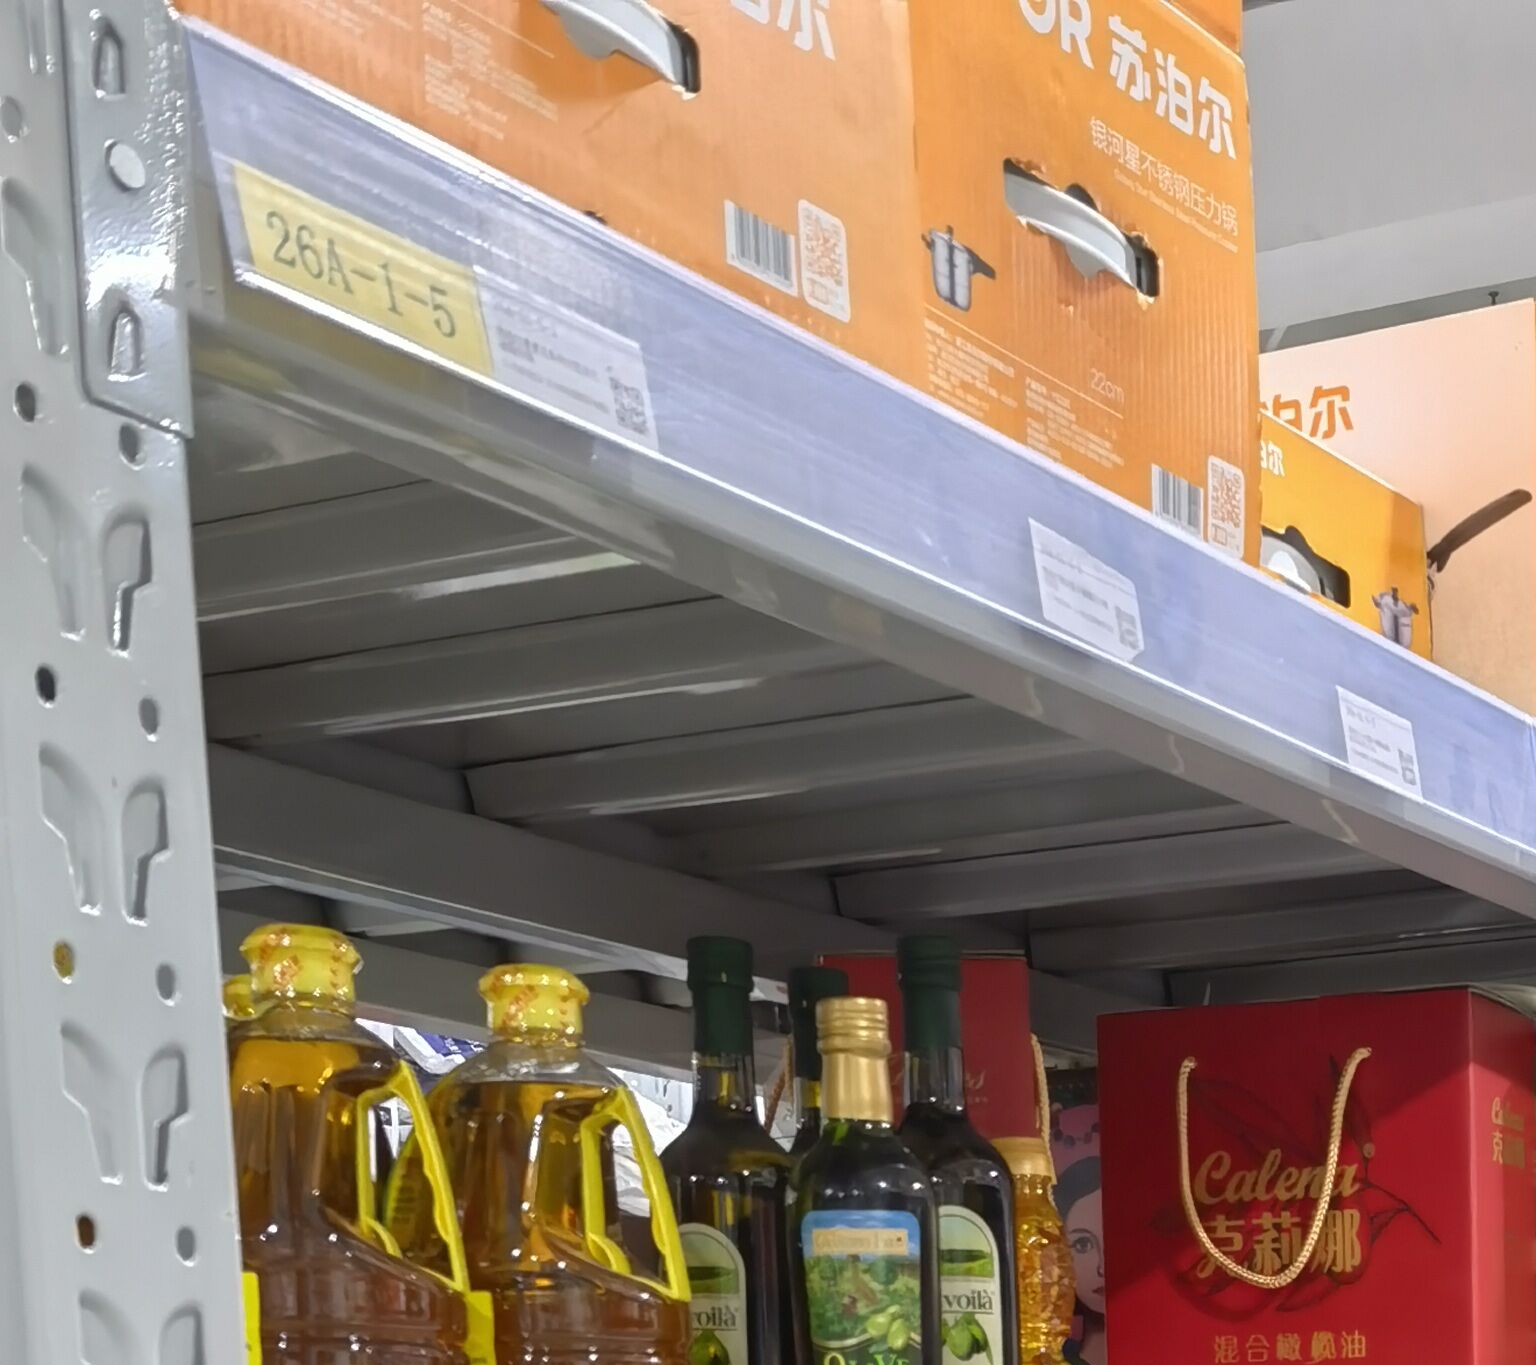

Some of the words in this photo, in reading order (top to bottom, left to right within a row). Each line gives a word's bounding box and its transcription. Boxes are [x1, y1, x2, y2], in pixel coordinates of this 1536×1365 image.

[1108, 15, 1237, 160] 苏泊尔
[1089, 116, 1238, 236] 银河星不锈钢压力锅
[265, 210, 457, 340] 26A-1-5
[1090, 367, 1125, 404] 22cm
